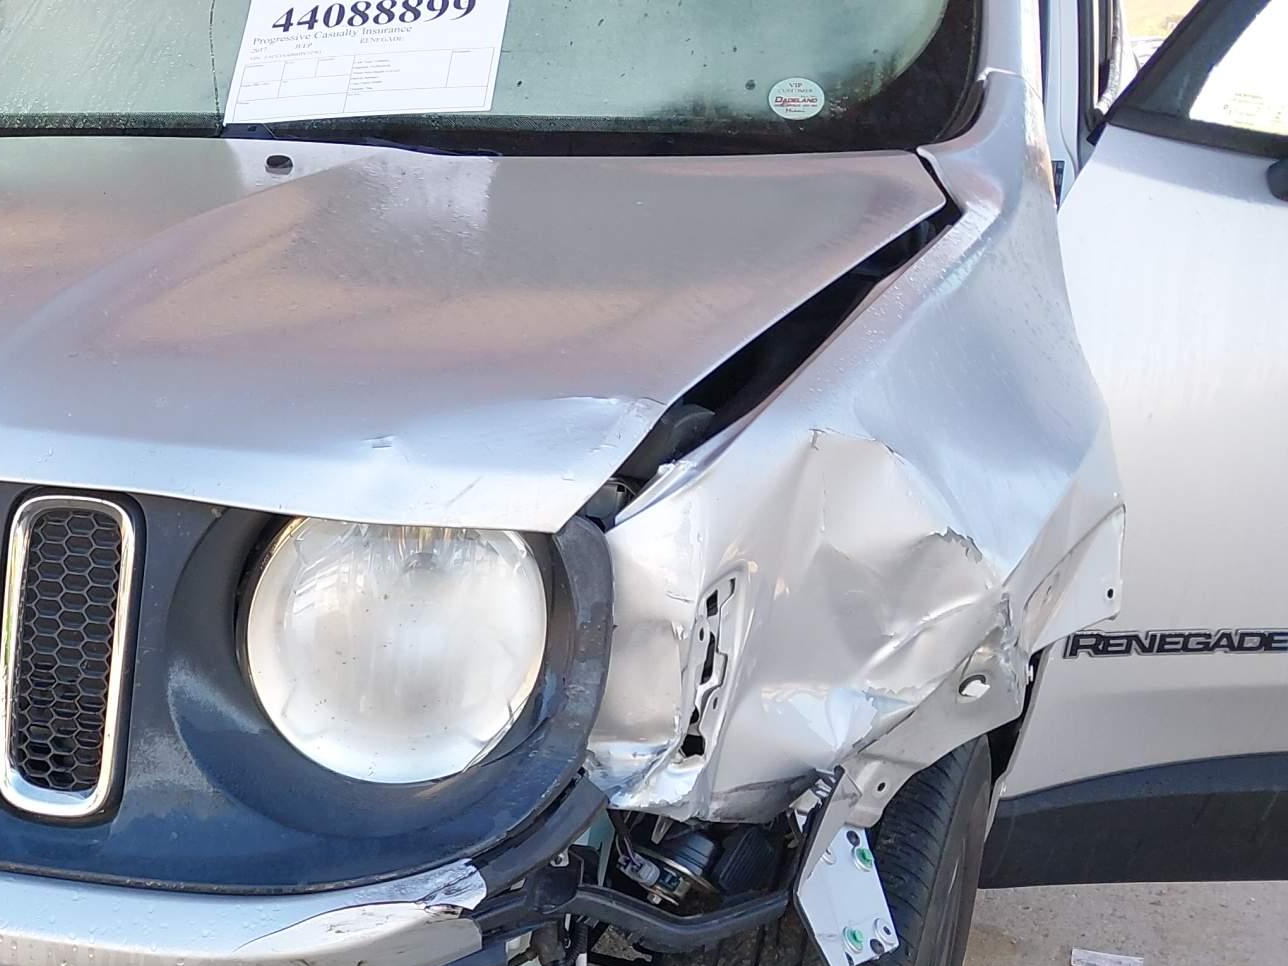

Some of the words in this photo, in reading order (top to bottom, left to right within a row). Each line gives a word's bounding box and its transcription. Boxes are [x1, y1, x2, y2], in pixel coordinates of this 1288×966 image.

[271, 0, 477, 32] 44088899
[253, 33, 312, 46] Progressive
[314, 28, 358, 39] Casualty
[362, 26, 413, 35] Insurance
[775, 96, 818, 104] DADELAND
[1063, 629, 1288, 659] RENEGADE
